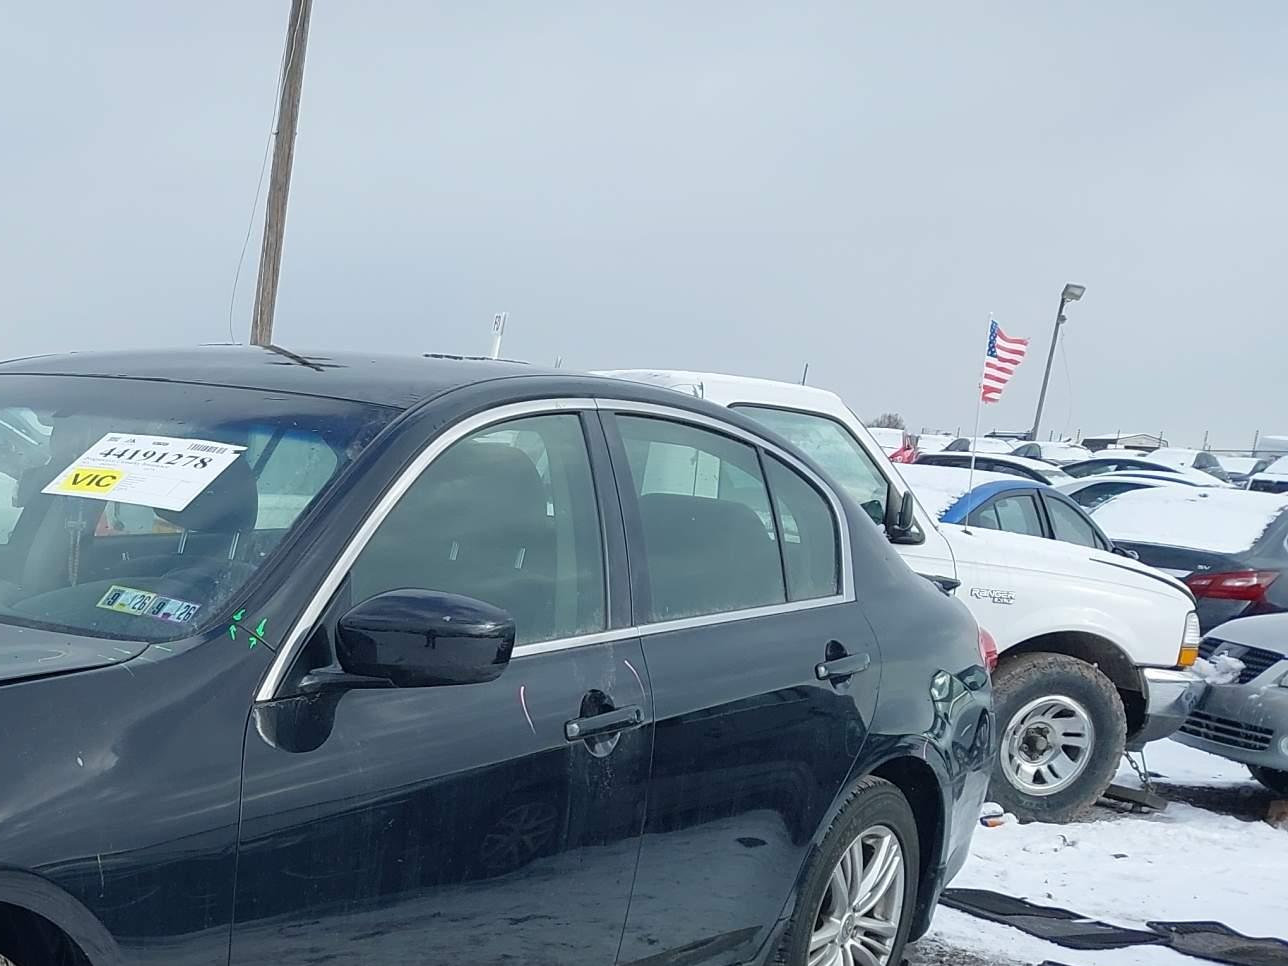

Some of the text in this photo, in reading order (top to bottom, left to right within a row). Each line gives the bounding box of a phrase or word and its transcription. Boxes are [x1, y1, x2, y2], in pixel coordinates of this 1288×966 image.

[99, 447, 213, 470] 44191278
[71, 473, 117, 488] VIC
[107, 592, 152, 612] 9 26
[152, 601, 196, 622] 9 26
